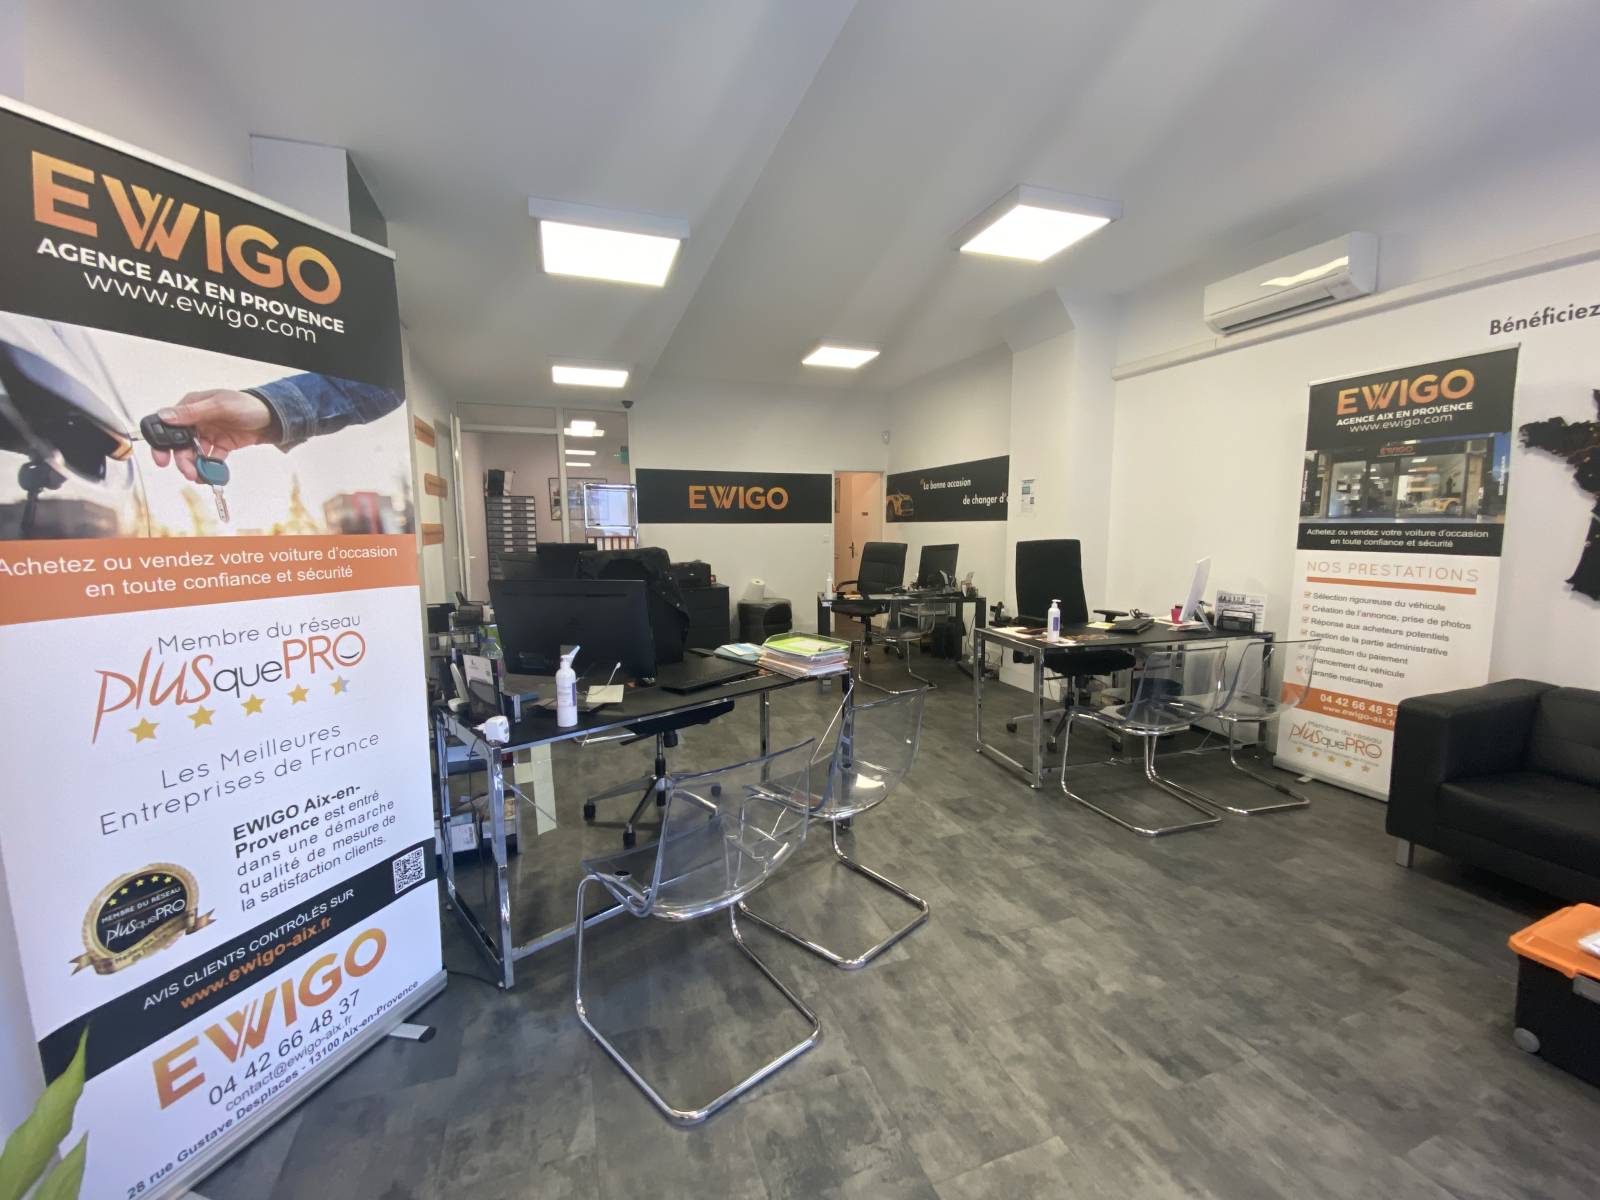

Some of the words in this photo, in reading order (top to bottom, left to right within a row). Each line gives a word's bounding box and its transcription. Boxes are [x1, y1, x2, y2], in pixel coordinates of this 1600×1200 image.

[31, 150, 342, 305] EWIGO
[37, 237, 151, 281] AGENCE
[157, 269, 200, 294] AIX
[205, 281, 235, 303] EN
[241, 293, 345, 334] PROVENCE
[83, 271, 318, 344] www.ewigo.com
[1489, 304, 1600, 335] Bénéficiez
[1336, 368, 1475, 416] EWIGO
[1336, 414, 1375, 426] AGENCE
[1376, 411, 1394, 421] AIX
[1396, 410, 1410, 419] EN
[1412, 402, 1473, 416] PROVENCE
[1350, 413, 1453, 432] www.ewigo.com
[688, 485, 789, 510] EWIGO
[962, 494, 970, 505] de
[971, 493, 997, 507] changer
[1307, 528, 1336, 536] Achetez
[1350, 528, 1379, 536] vendez
[1404, 529, 1436, 537] voiture
[1438, 529, 1489, 538] d'occasion
[1363, 538, 1404, 546] confiance
[1406, 539, 1416, 547] et
[0, 557, 96, 576] Achetez
[104, 557, 132, 571] ou
[139, 551, 215, 568] vendez
[219, 551, 264, 565] votre
[269, 547, 323, 562] voiture
[328, 546, 398, 560] d'occasion
[85, 583, 114, 597] en
[122, 577, 177, 595] toute
[183, 571, 271, 590] confiance
[276, 569, 292, 583] et
[297, 565, 353, 581] sécurité
[1307, 561, 1341, 574] NOS
[1348, 562, 1479, 582] PRESTATIONS
[158, 628, 260, 655] Membre
[266, 621, 292, 640] du
[300, 615, 361, 634] réseau
[1402, 615, 1424, 624] prise
[1441, 620, 1471, 630] photos
[1356, 650, 1367, 658] du
[1368, 653, 1408, 665] paiement
[1357, 664, 1368, 672] du
[1361, 638, 1384, 648] partie
[1386, 642, 1448, 657] administrative
[1320, 693, 1332, 703] 04
[1335, 697, 1349, 707] 42
[1368, 704, 1383, 715] 48
[161, 761, 210, 789] Les
[220, 723, 342, 771] Meilleures
[100, 772, 266, 836] Entreprises
[274, 756, 303, 778] de
[311, 732, 380, 766] France
[233, 804, 300, 841] EWIGO
[304, 785, 361, 813] Aix-en-
[235, 816, 320, 858] Provence
[324, 806, 346, 822] est
[349, 789, 380, 812] entré
[237, 851, 281, 876] dans
[288, 834, 319, 854] une
[325, 800, 395, 837] démarche
[239, 858, 300, 895] qualité
[307, 847, 326, 862] de
[333, 823, 379, 851] mesure
[382, 814, 396, 828] de
[242, 898, 256, 912] la
[260, 858, 341, 902] satisfaction
[345, 835, 386, 861] clients.
[101, 905, 136, 924] MEMBRE
[137, 900, 149, 910] DU
[144, 982, 180, 1011] AVIS
[183, 947, 246, 987] CLIENTS
[249, 905, 327, 952] CONTRÔLÉS
[330, 888, 355, 908] SUR
[180, 916, 332, 1009] www.ewigo-aix.fr
[152, 928, 387, 1110] EWIGO
[209, 1076, 238, 1105] 04
[244, 1052, 272, 1080] 42
[278, 1030, 303, 1057] 66
[309, 1010, 333, 1034] 48
[339, 988, 360, 1015] 37
[225, 1014, 353, 1112] contact@ewigo-aix.fr
[126, 1181, 146, 1200] 28
[149, 1162, 174, 1183] rue
[177, 1118, 233, 1162] Gustave
[236, 1069, 299, 1121] Desplaces
[309, 1038, 340, 1065] 13100
[342, 980, 419, 1042] Aix-en-Provence
